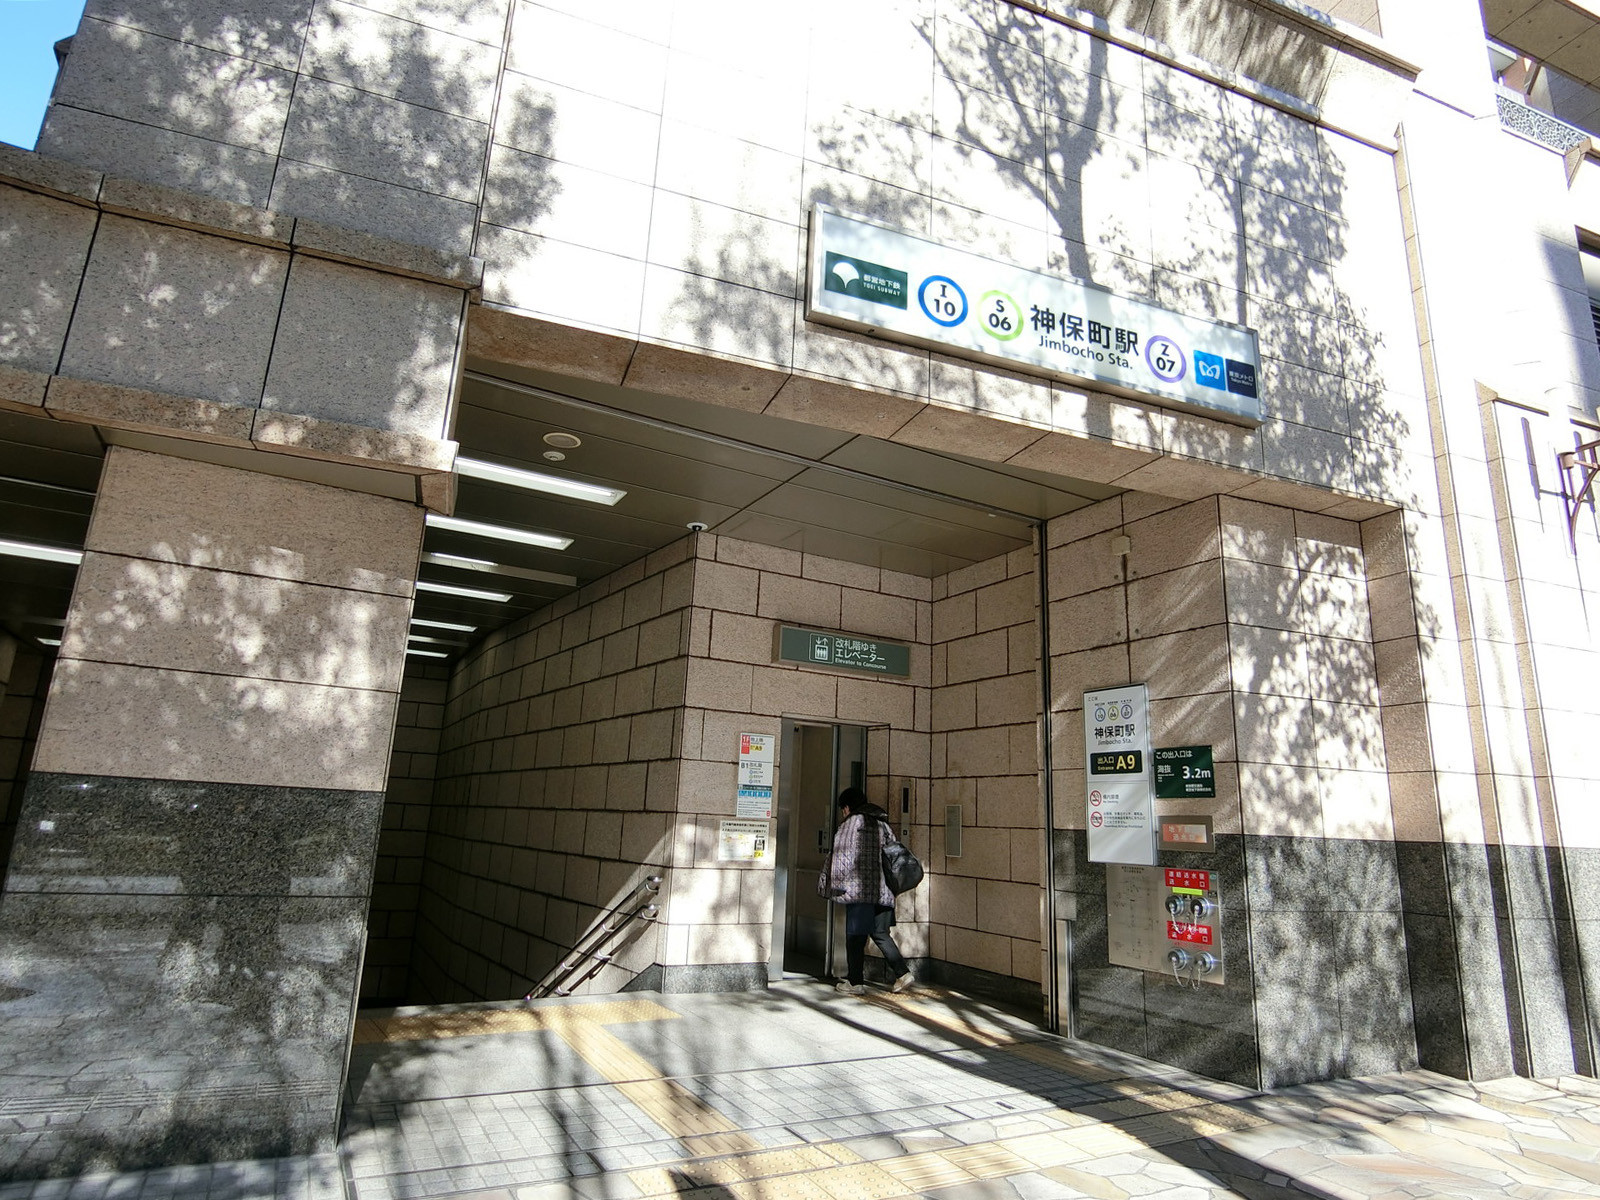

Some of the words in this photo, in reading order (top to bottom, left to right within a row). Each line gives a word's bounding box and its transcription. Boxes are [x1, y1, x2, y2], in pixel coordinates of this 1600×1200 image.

[863, 273, 901, 290] 都営地下鉄
[863, 282, 877, 291] TOEI
[877, 285, 901, 297] SUBWAY
[940, 283, 948, 298] I
[934, 298, 956, 317] 10
[996, 299, 1005, 313] S
[988, 313, 1012, 332] 06
[1030, 304, 1139, 356] 神保町駅
[1038, 335, 1104, 362] Jimbocho
[1108, 352, 1133, 370] Sta.
[1161, 343, 1170, 357] Z
[1156, 357, 1176, 373] 07
[1229, 370, 1254, 382] 東京メトロ
[835, 638, 877, 653] 改札階ゆき
[835, 648, 885, 662] エレベーター
[835, 657, 855, 665] Elevator
[863, 661, 887, 670] Concourse
[1094, 723, 1136, 740] 神保町駅
[1097, 756, 1115, 765] 出入口
[1116, 754, 1136, 770] A9
[1155, 750, 1193, 760] この出入口は
[1157, 764, 1172, 774] 海抜
[1181, 765, 1212, 780] 3.2m
